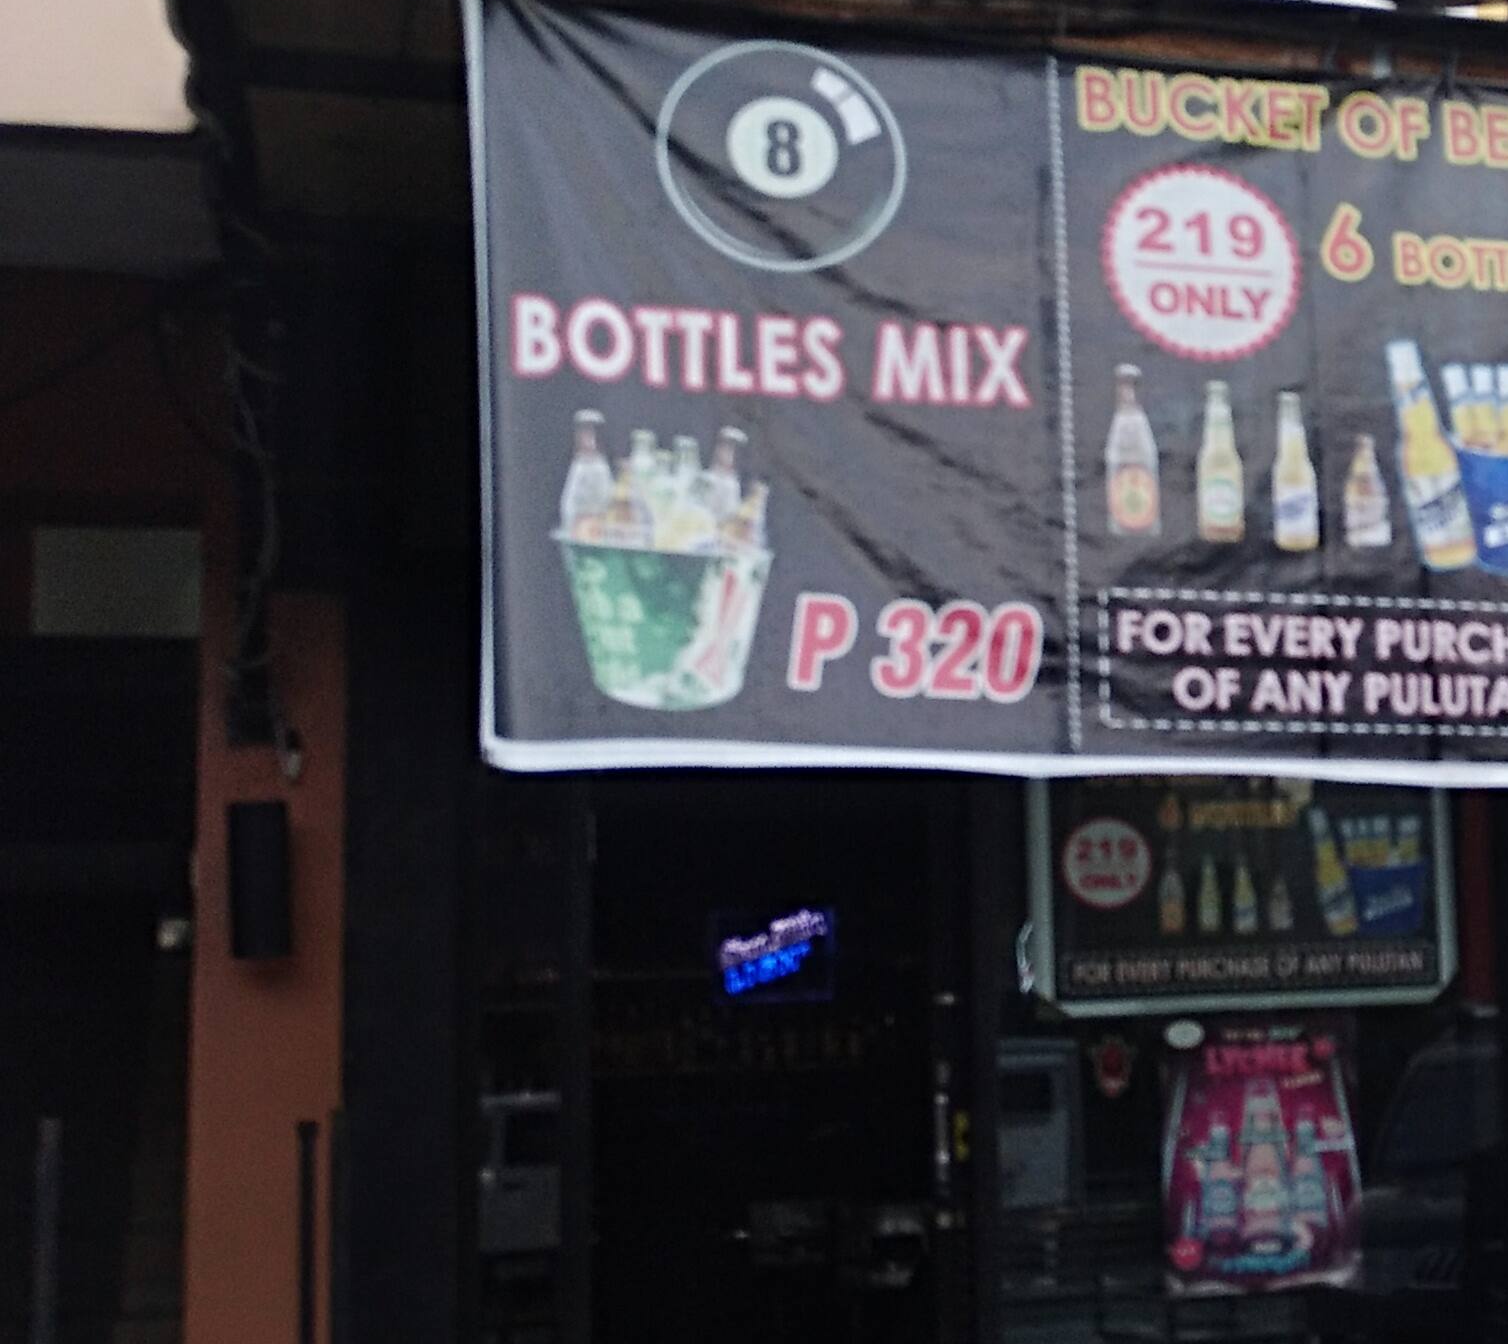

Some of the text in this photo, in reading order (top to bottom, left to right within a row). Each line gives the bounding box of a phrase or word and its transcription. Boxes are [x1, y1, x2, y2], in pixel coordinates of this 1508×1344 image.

[1076, 66, 1329, 152] BUCKET
[1337, 90, 1431, 162] OF
[764, 120, 804, 178] 8
[1134, 207, 1266, 259] 219
[1321, 202, 1374, 282] 6
[1148, 282, 1272, 322] ONLY
[511, 294, 1033, 409] BOTTLES MIX
[787, 592, 1043, 703] P 320
[1115, 609, 1214, 657] FOR
[1223, 613, 1365, 660] EVERY
[1172, 666, 1242, 712] OF
[1250, 669, 1353, 716] ANY
